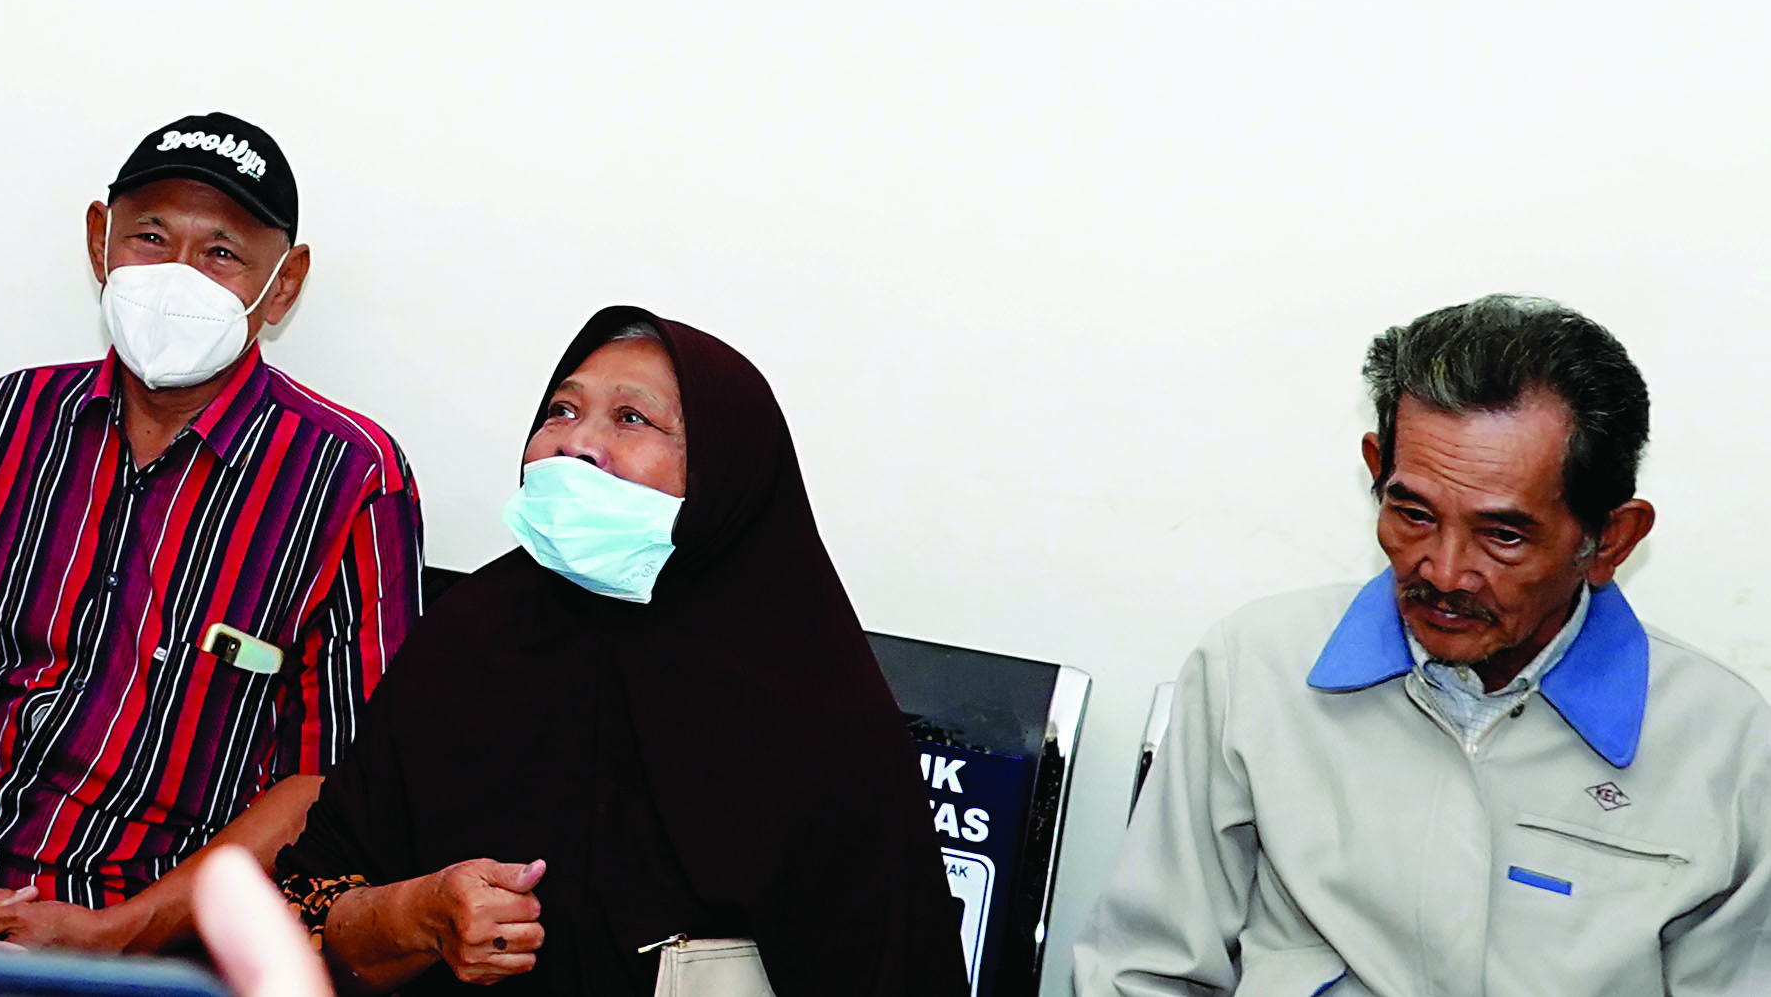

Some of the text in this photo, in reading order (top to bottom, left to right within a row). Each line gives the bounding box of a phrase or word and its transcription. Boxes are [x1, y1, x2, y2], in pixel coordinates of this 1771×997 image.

[157, 130, 266, 176] Brooklyn
[929, 800, 989, 842] AS
[945, 862, 968, 878] AK
